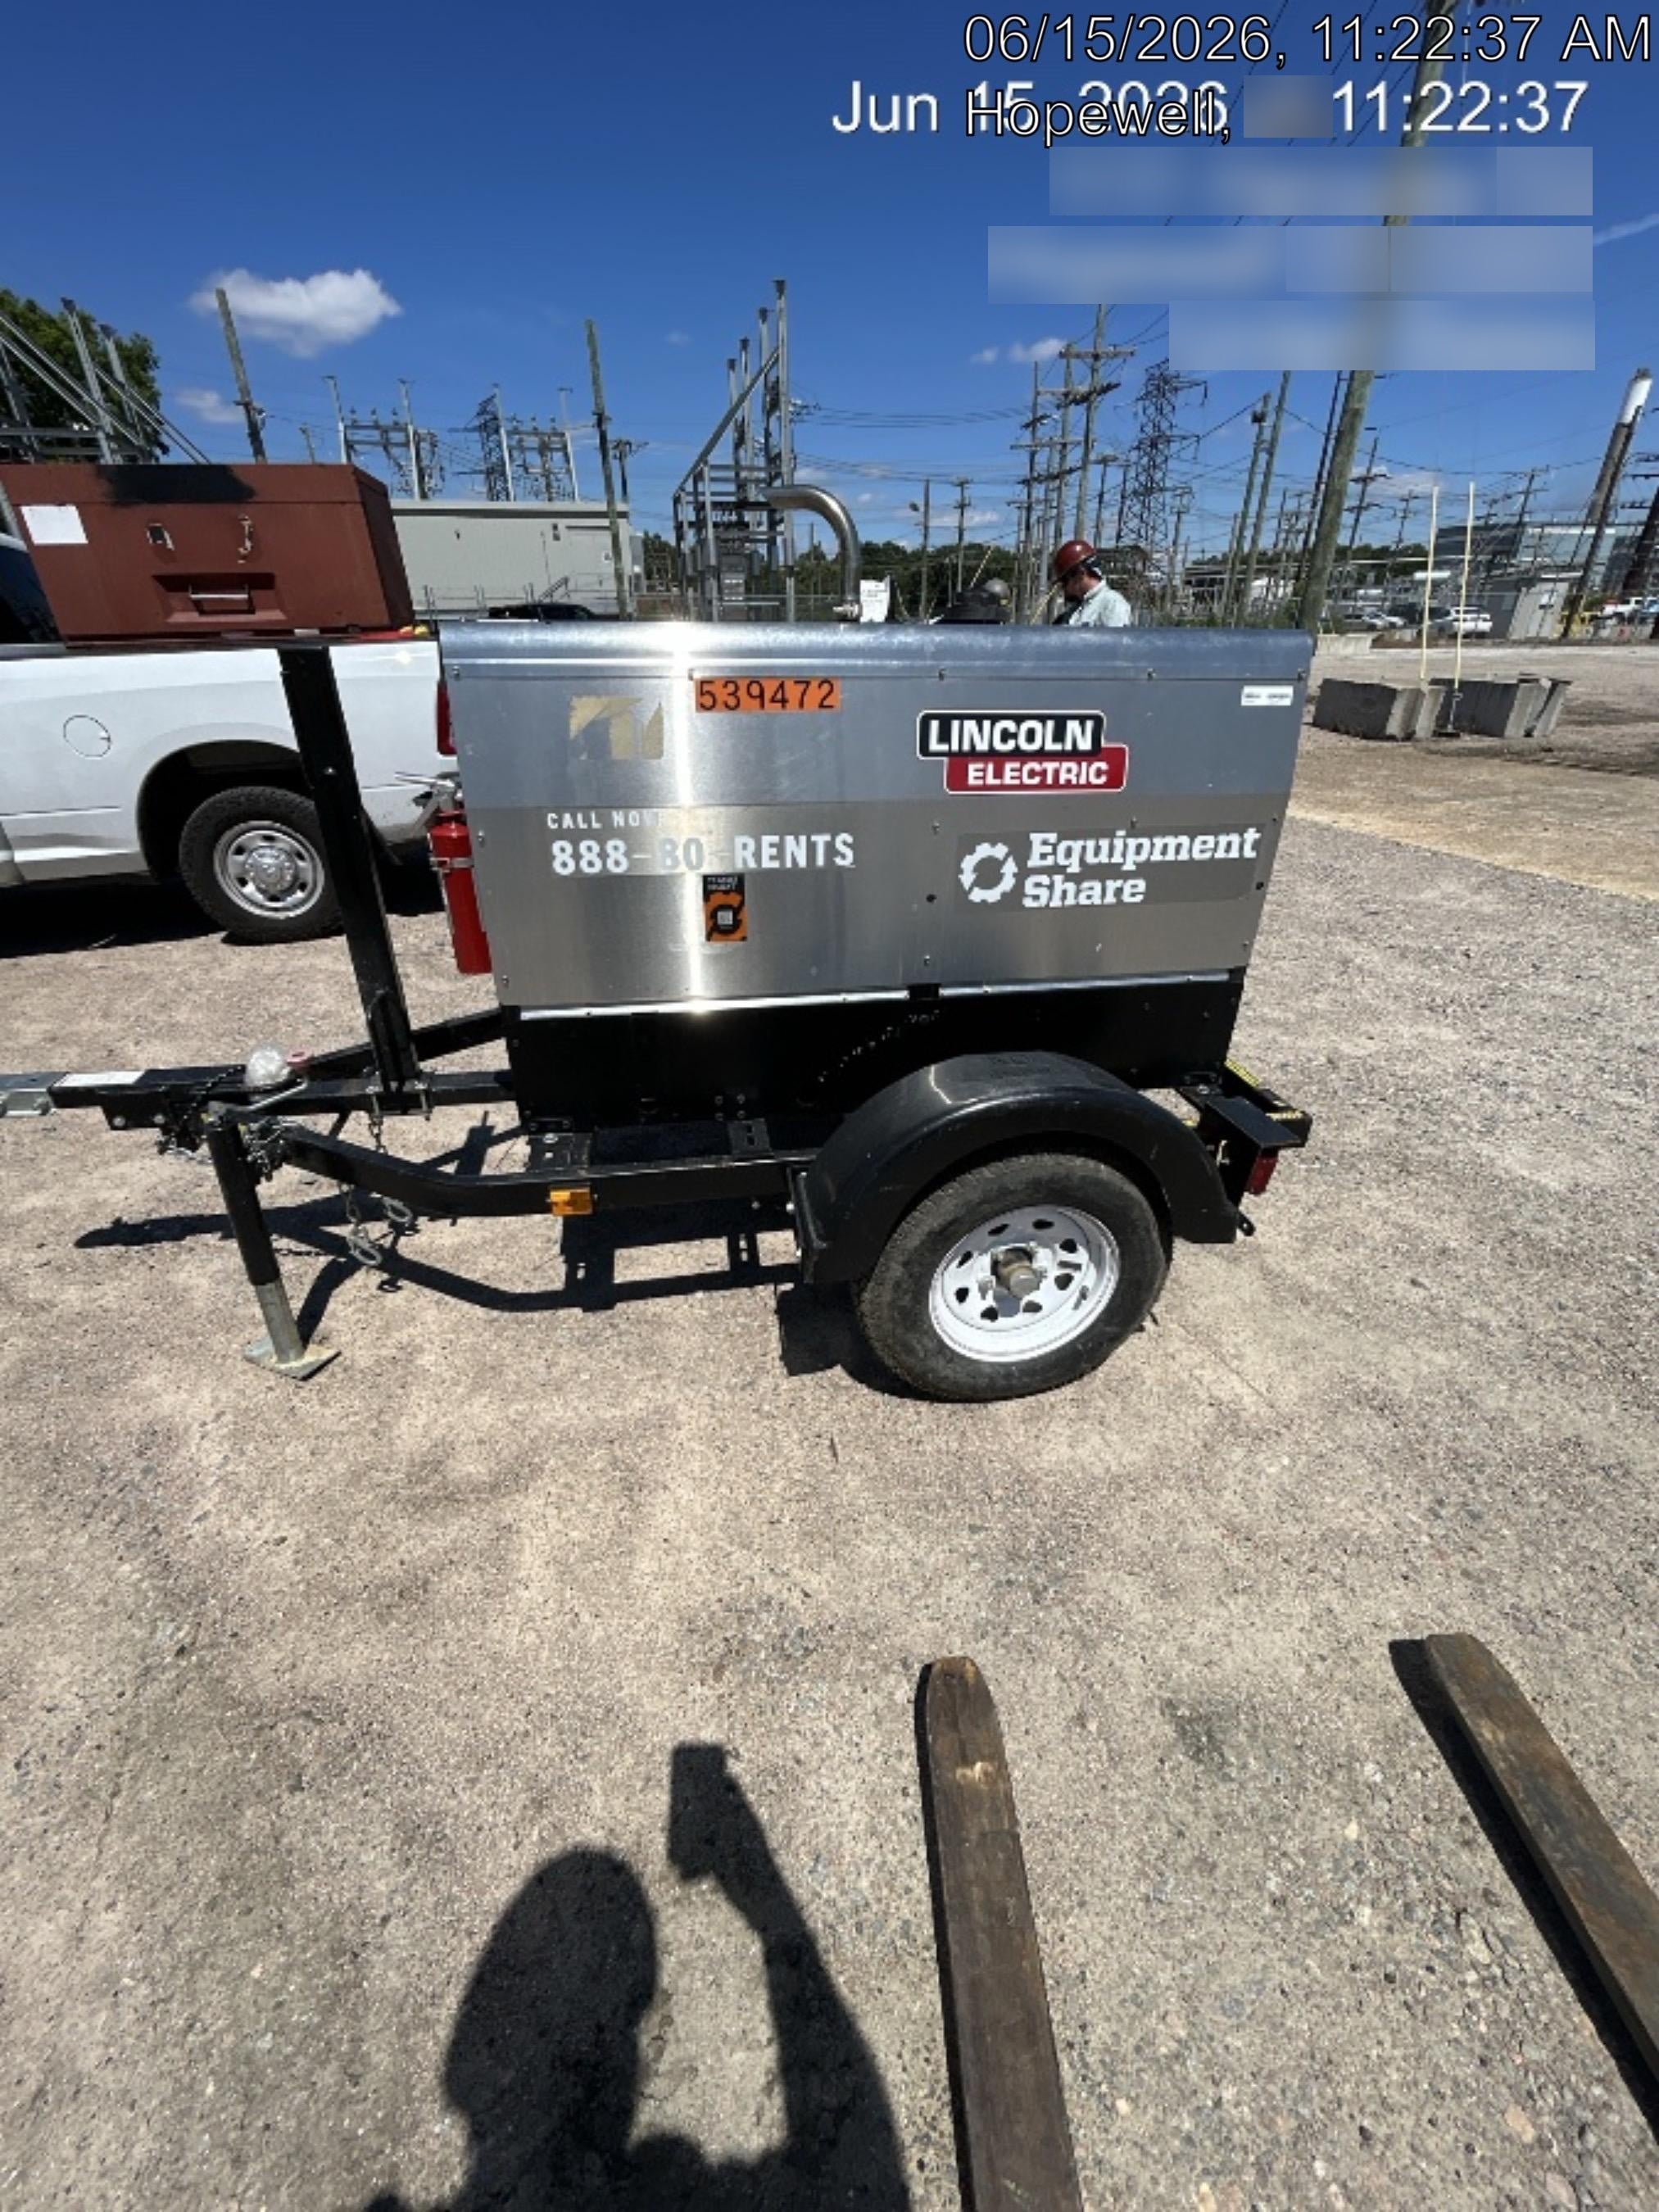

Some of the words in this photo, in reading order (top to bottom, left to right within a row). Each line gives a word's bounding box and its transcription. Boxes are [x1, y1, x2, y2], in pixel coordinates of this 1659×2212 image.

[699, 679, 837, 711] 539472
[927, 718, 1095, 754] LINCOLN
[967, 760, 1109, 786] ELECTRIC
[546, 811, 602, 829] CALL
[1027, 827, 1262, 873] Equipment
[1022, 873, 1147, 908] Share
